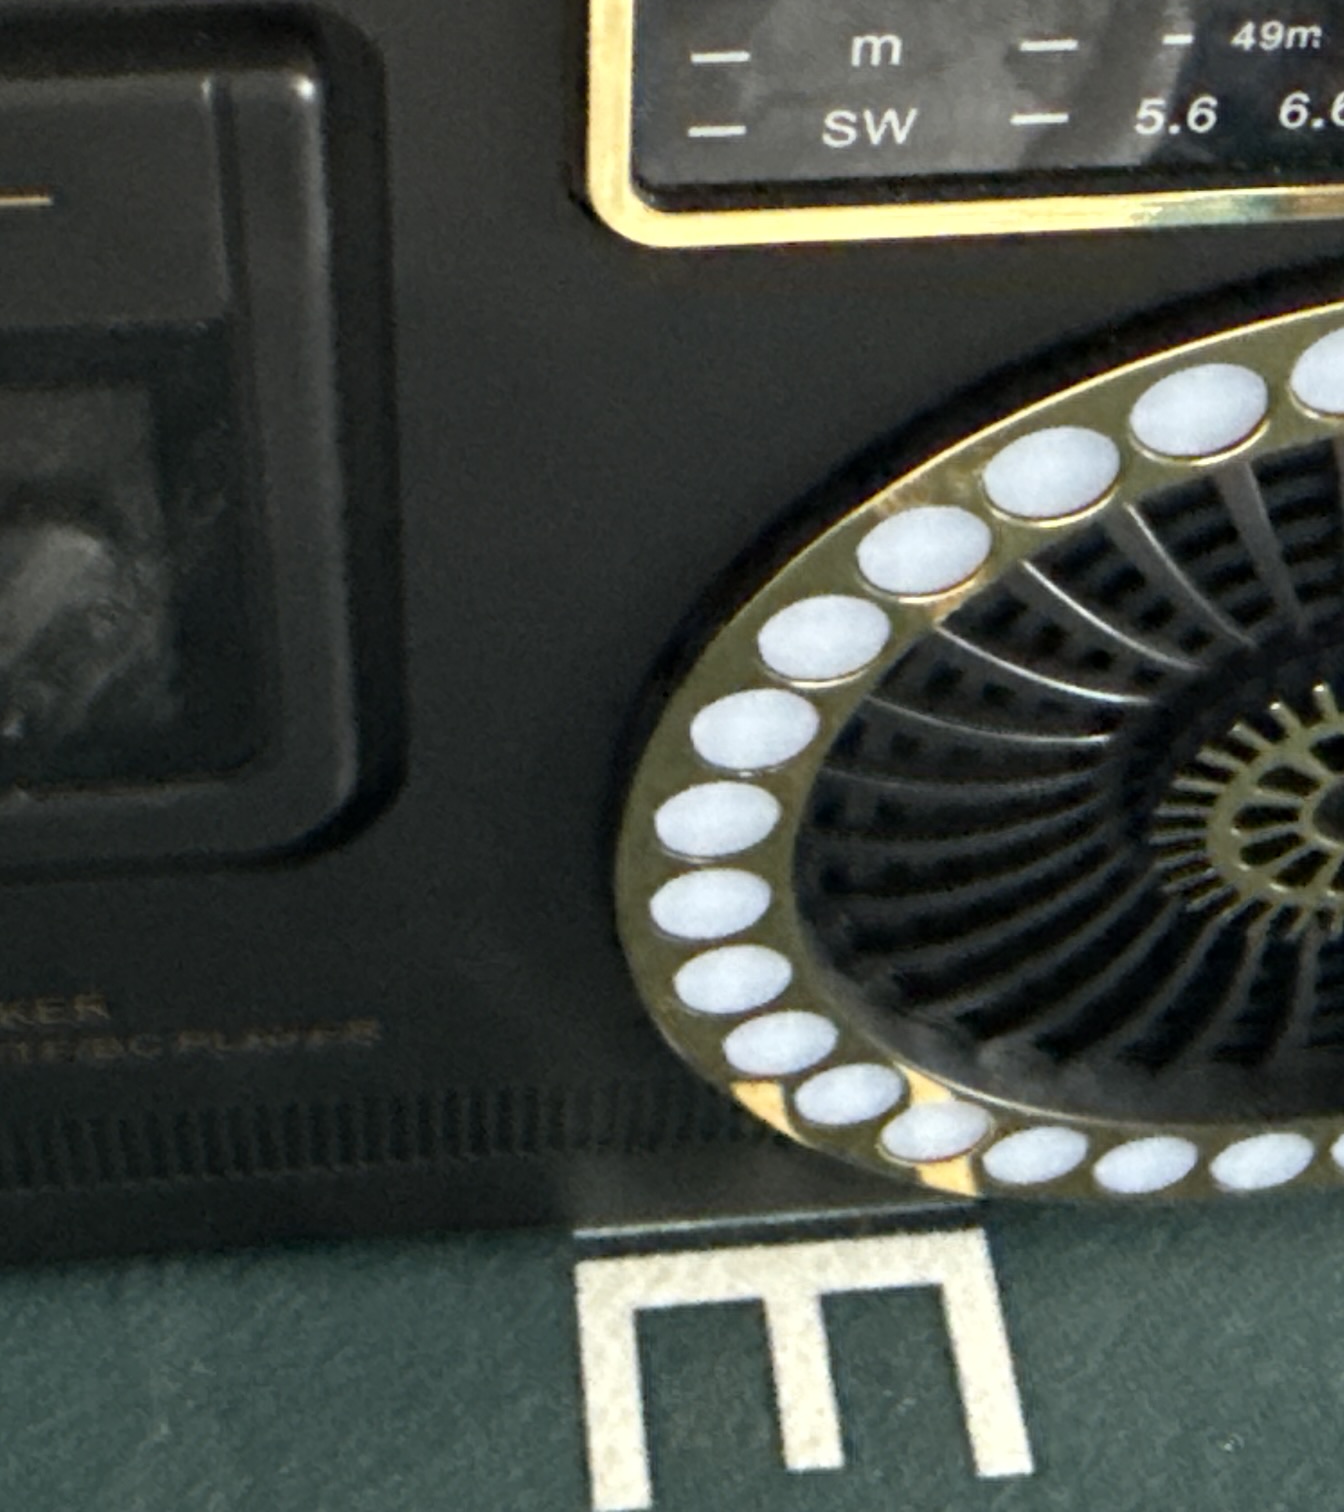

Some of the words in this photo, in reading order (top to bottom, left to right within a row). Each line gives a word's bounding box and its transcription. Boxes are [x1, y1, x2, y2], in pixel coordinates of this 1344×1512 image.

[851, 34, 902, 67] m
[1231, 20, 1322, 51] 49m
[822, 108, 918, 148] SW
[1133, 94, 1218, 135] 5.6
